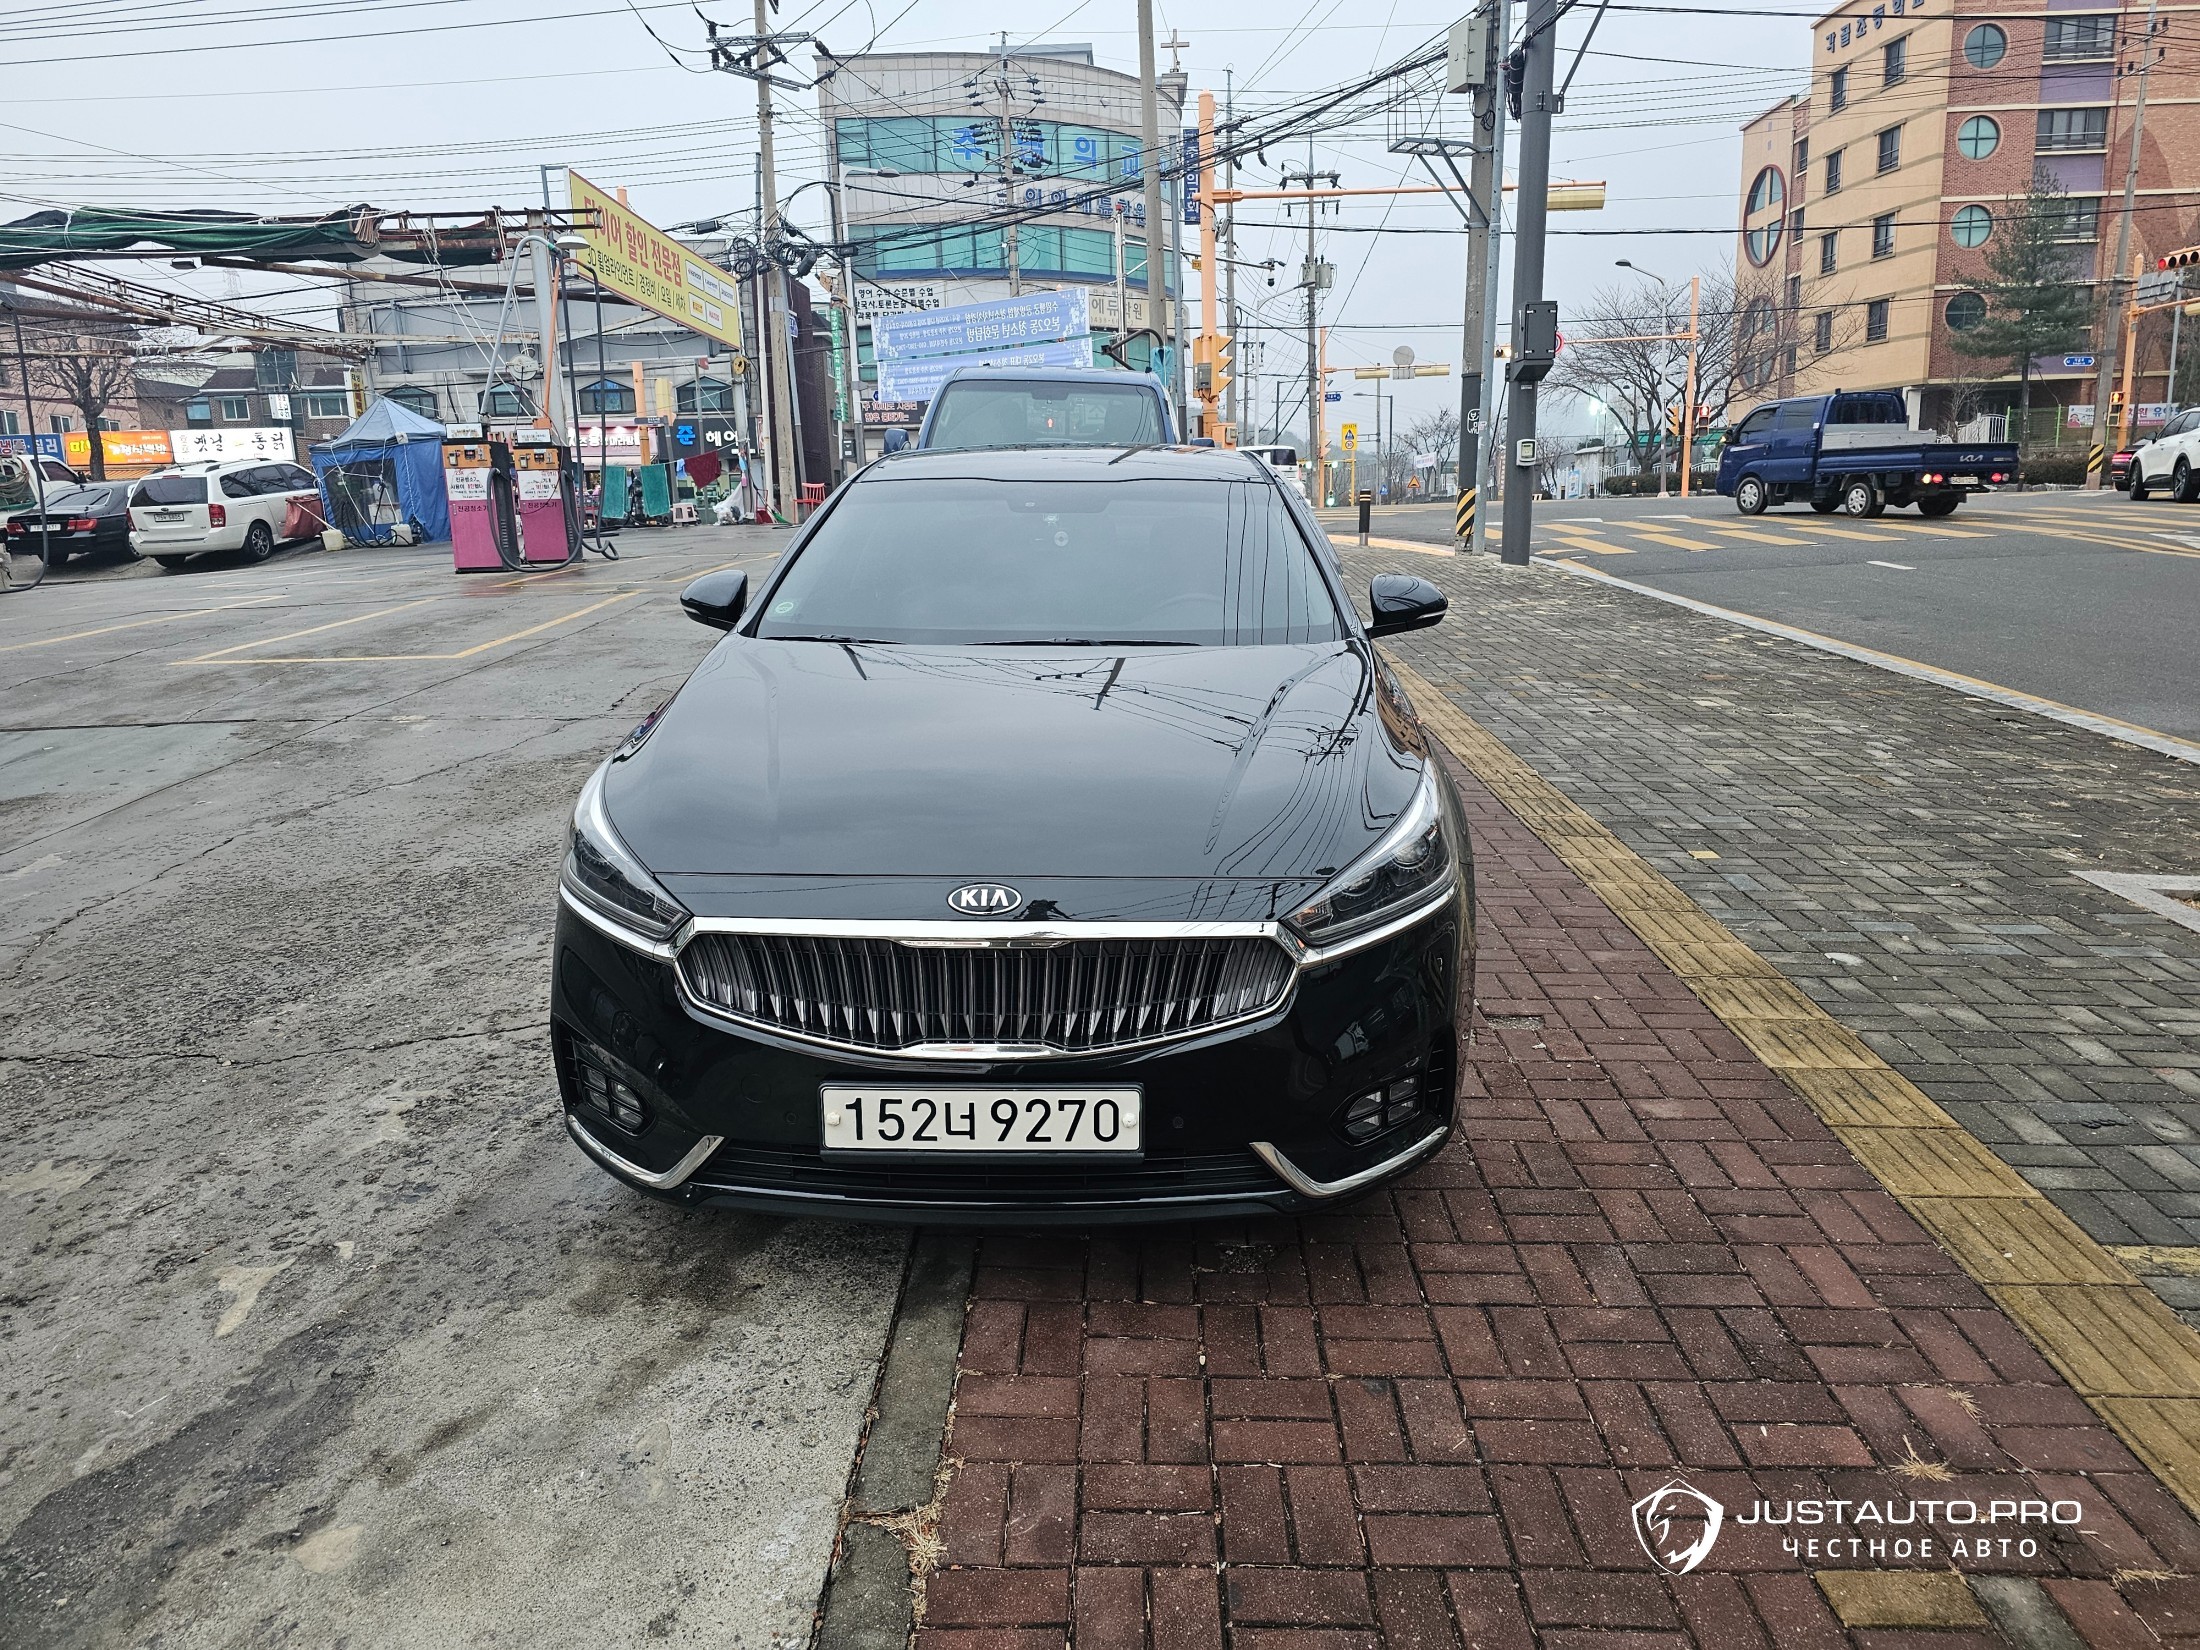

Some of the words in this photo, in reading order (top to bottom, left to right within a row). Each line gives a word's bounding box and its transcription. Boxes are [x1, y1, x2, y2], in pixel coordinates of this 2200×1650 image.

[583, 195, 623, 254] 타이어
[624, 220, 649, 269] 할인
[650, 238, 682, 288] 전문점
[638, 273, 657, 300] 경정비
[660, 285, 672, 308] 오일
[858, 289, 873, 299] 영어
[919, 287, 933, 297] 수업
[194, 433, 223, 452] 옛날
[251, 431, 285, 450] 통닭
[705, 430, 739, 447] 헤어
[960, 888, 1009, 907] KIA
